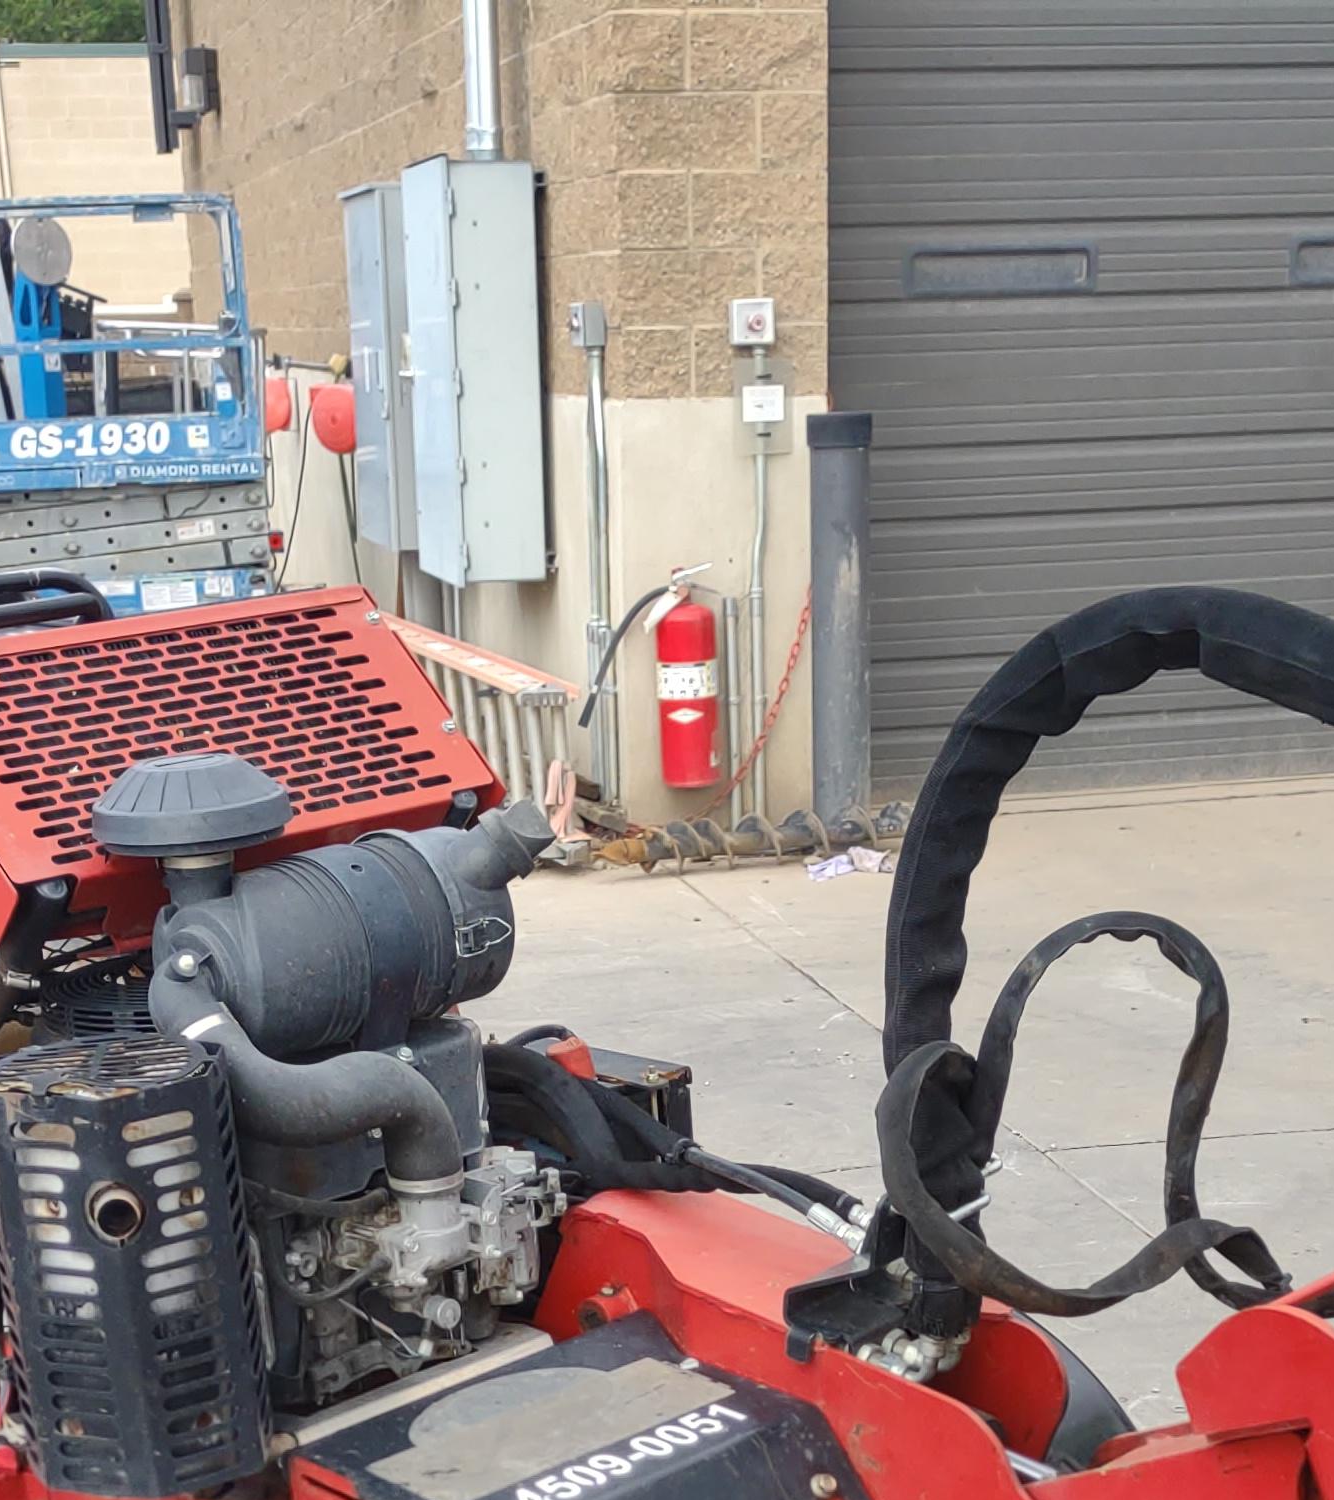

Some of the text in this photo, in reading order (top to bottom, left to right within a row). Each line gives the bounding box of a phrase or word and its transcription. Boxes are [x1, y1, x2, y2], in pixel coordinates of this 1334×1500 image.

[9, 421, 170, 459] GS-1930
[130, 462, 260, 478] DIAMOND RENTAL
